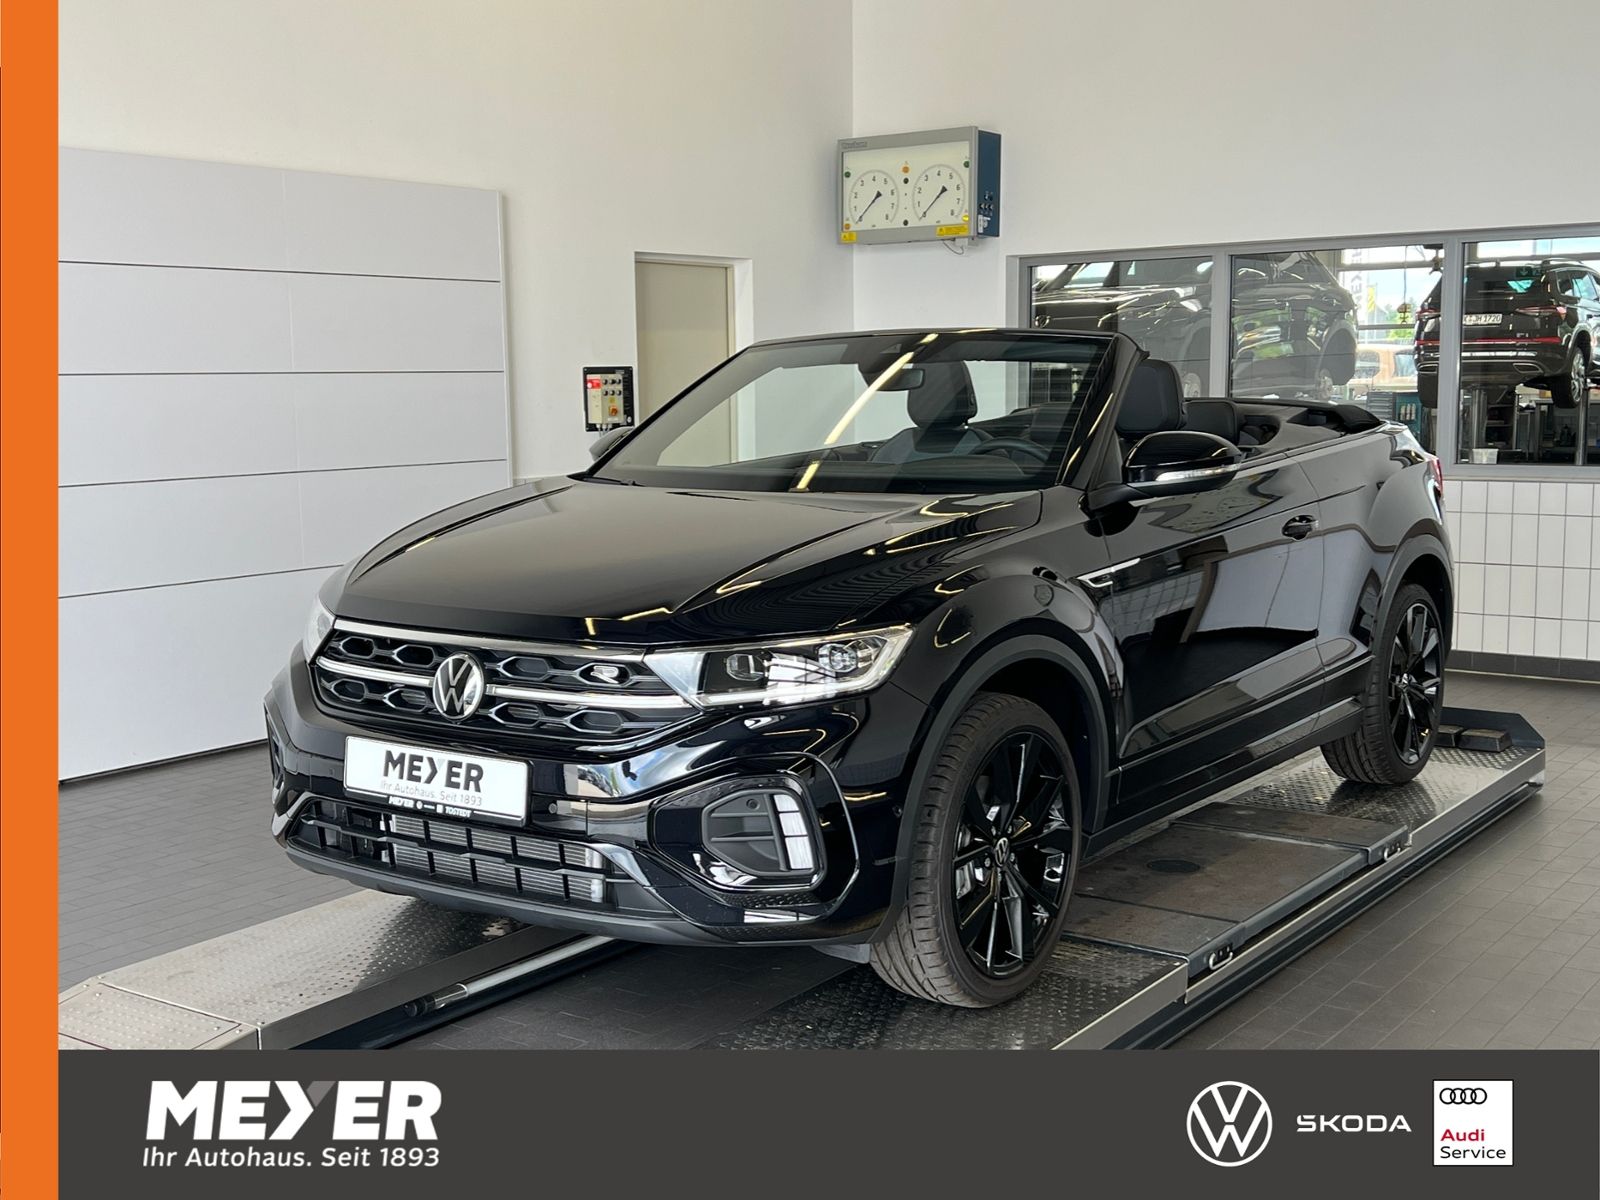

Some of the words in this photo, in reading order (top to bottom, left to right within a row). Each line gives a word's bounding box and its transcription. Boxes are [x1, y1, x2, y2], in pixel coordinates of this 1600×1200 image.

[432, 653, 483, 720] VW
[383, 750, 484, 793] MEYER
[394, 782, 435, 799] Autohaus.
[440, 790, 457, 802] Seit
[460, 793, 482, 807] 1893
